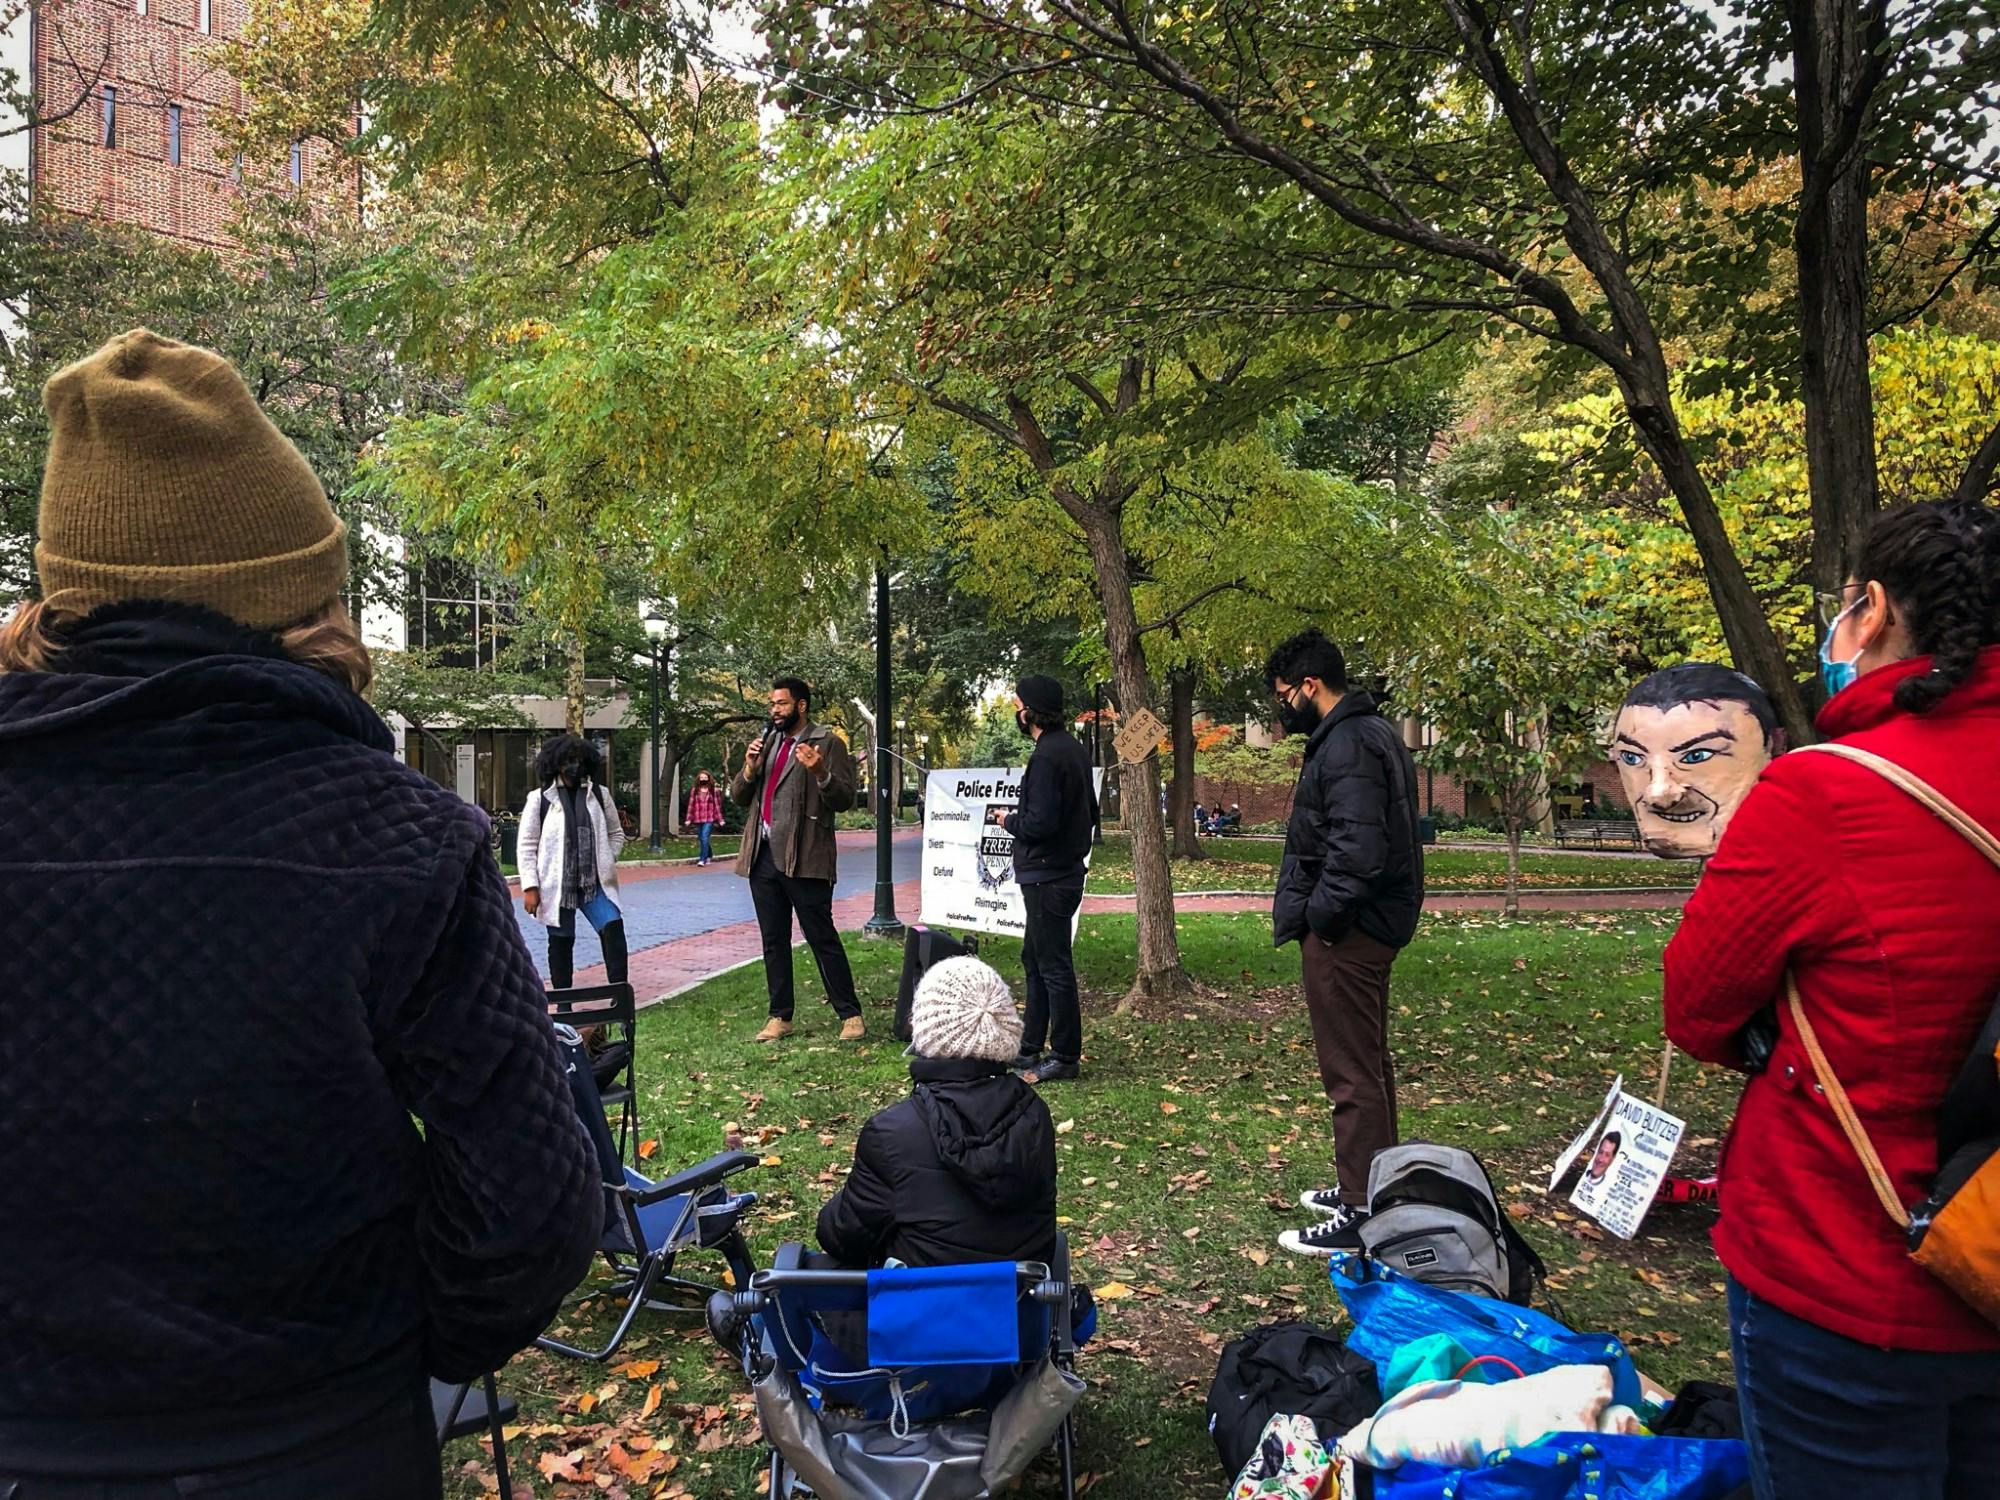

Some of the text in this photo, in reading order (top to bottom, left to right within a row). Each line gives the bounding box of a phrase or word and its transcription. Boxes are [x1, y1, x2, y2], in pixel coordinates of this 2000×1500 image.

[1120, 713, 1149, 748] WE KEEP
[1130, 743, 1144, 758] US
[955, 779, 1022, 798] Police Free
[930, 810, 971, 821] Decriminalize
[983, 838, 1013, 854] FREE
[985, 856, 1008, 868] PENN
[933, 866, 954, 877] Defund
[974, 896, 1008, 911] Reimagine
[1615, 1099, 1643, 1124] DAVID
[1641, 1111, 1680, 1142] BLITZER
